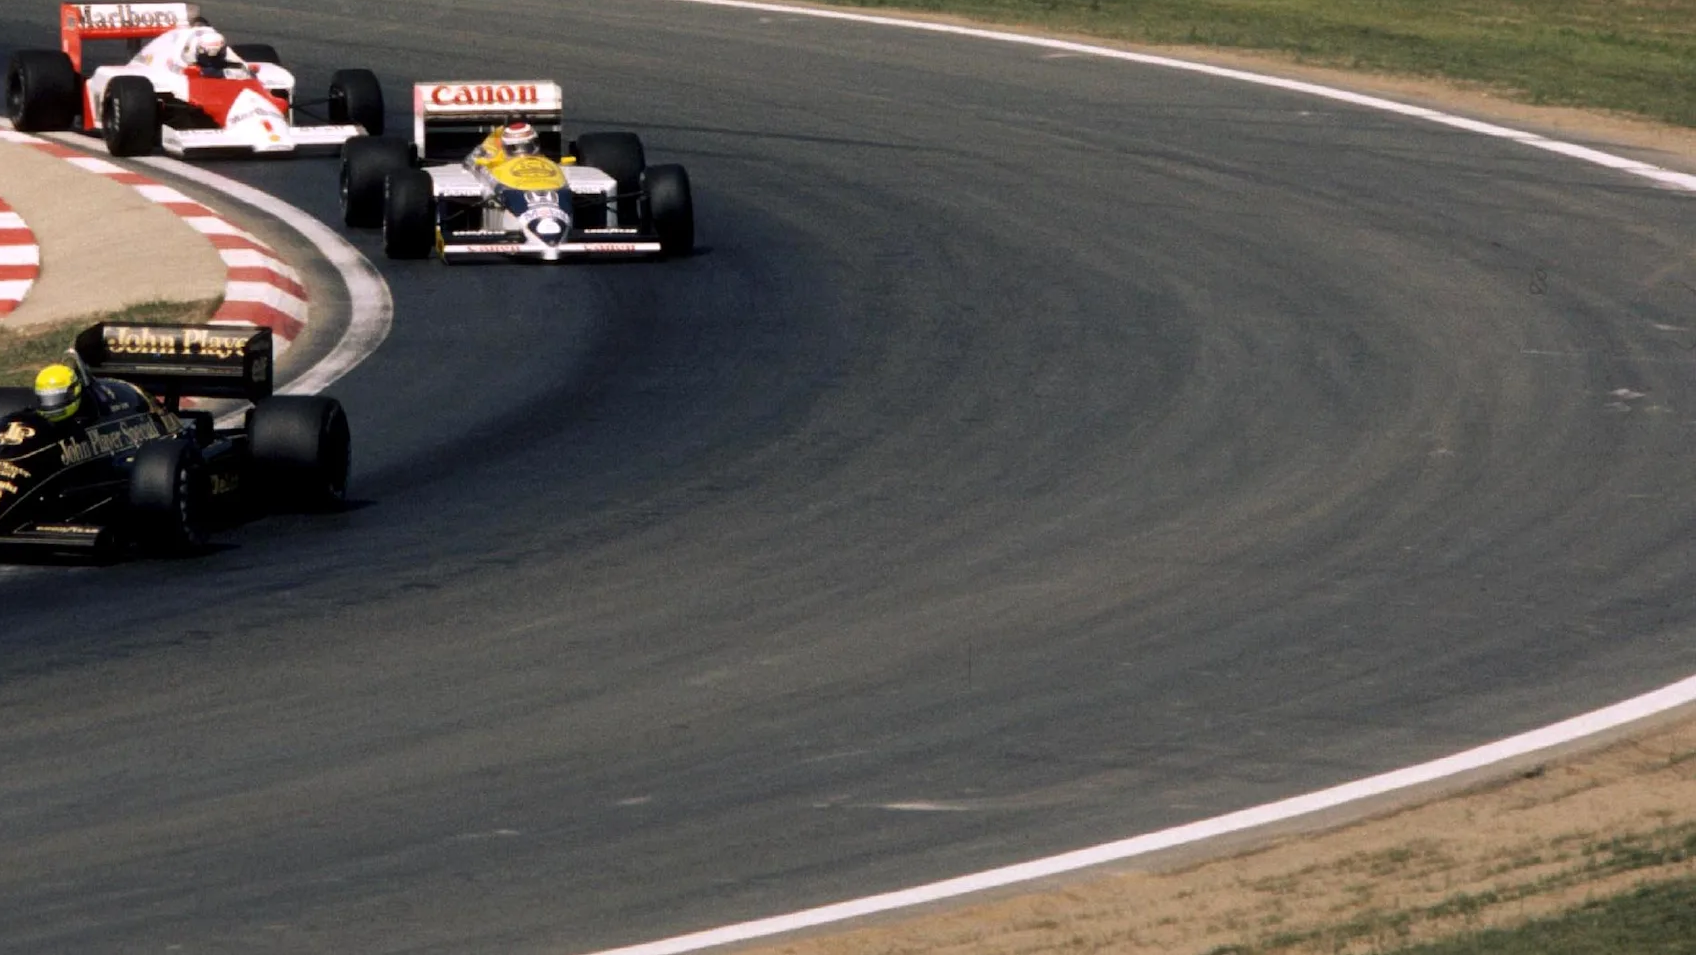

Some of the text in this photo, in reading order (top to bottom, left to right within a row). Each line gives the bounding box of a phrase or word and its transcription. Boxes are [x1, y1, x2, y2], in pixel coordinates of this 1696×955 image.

[77, 4, 178, 28] Marlboro
[431, 84, 539, 105] Canon
[107, 326, 176, 354] John
[58, 436, 92, 466] John
